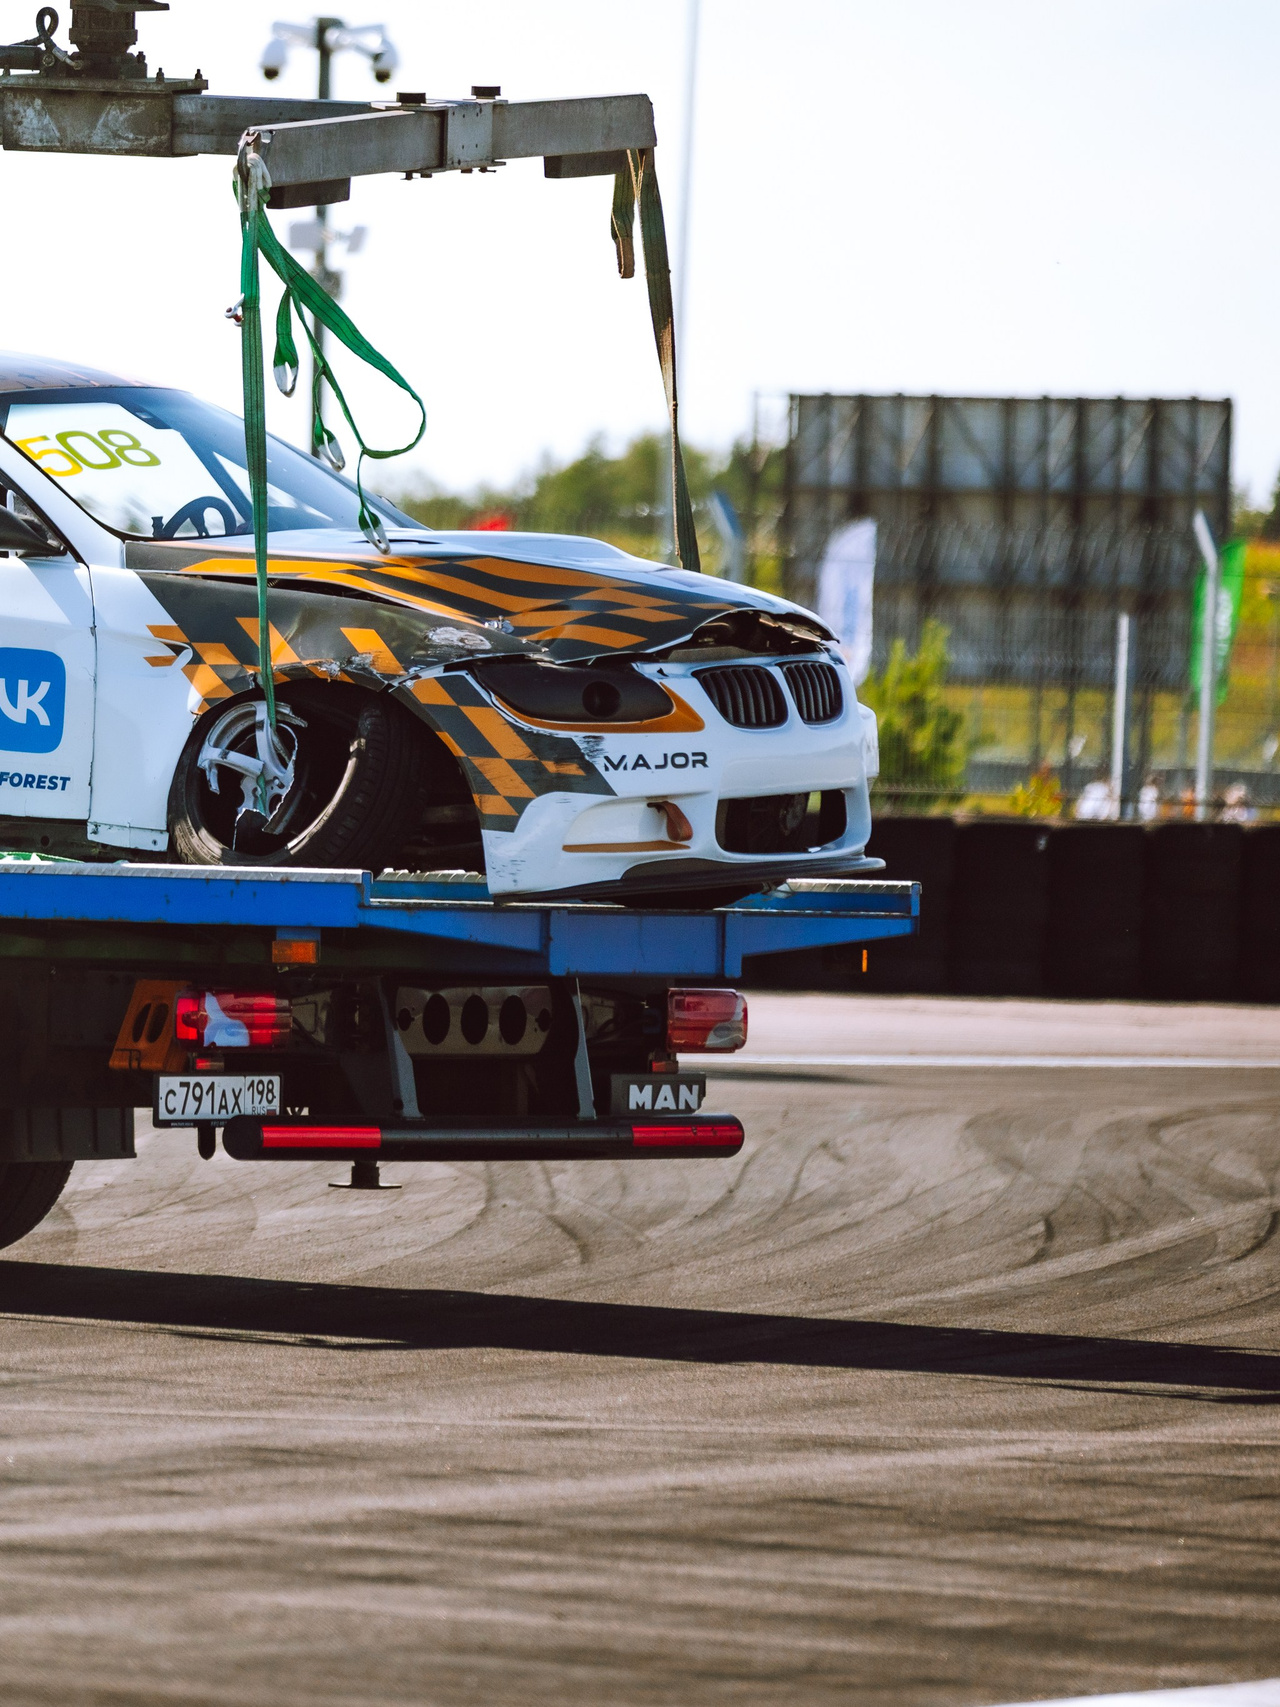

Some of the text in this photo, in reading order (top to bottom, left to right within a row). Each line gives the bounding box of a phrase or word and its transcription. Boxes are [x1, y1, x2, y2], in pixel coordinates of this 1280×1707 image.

[14, 429, 161, 477] 508
[603, 752, 709, 772] MAJOR
[629, 1084, 699, 1110] MAN
[252, 1106, 266, 1116] RUS
